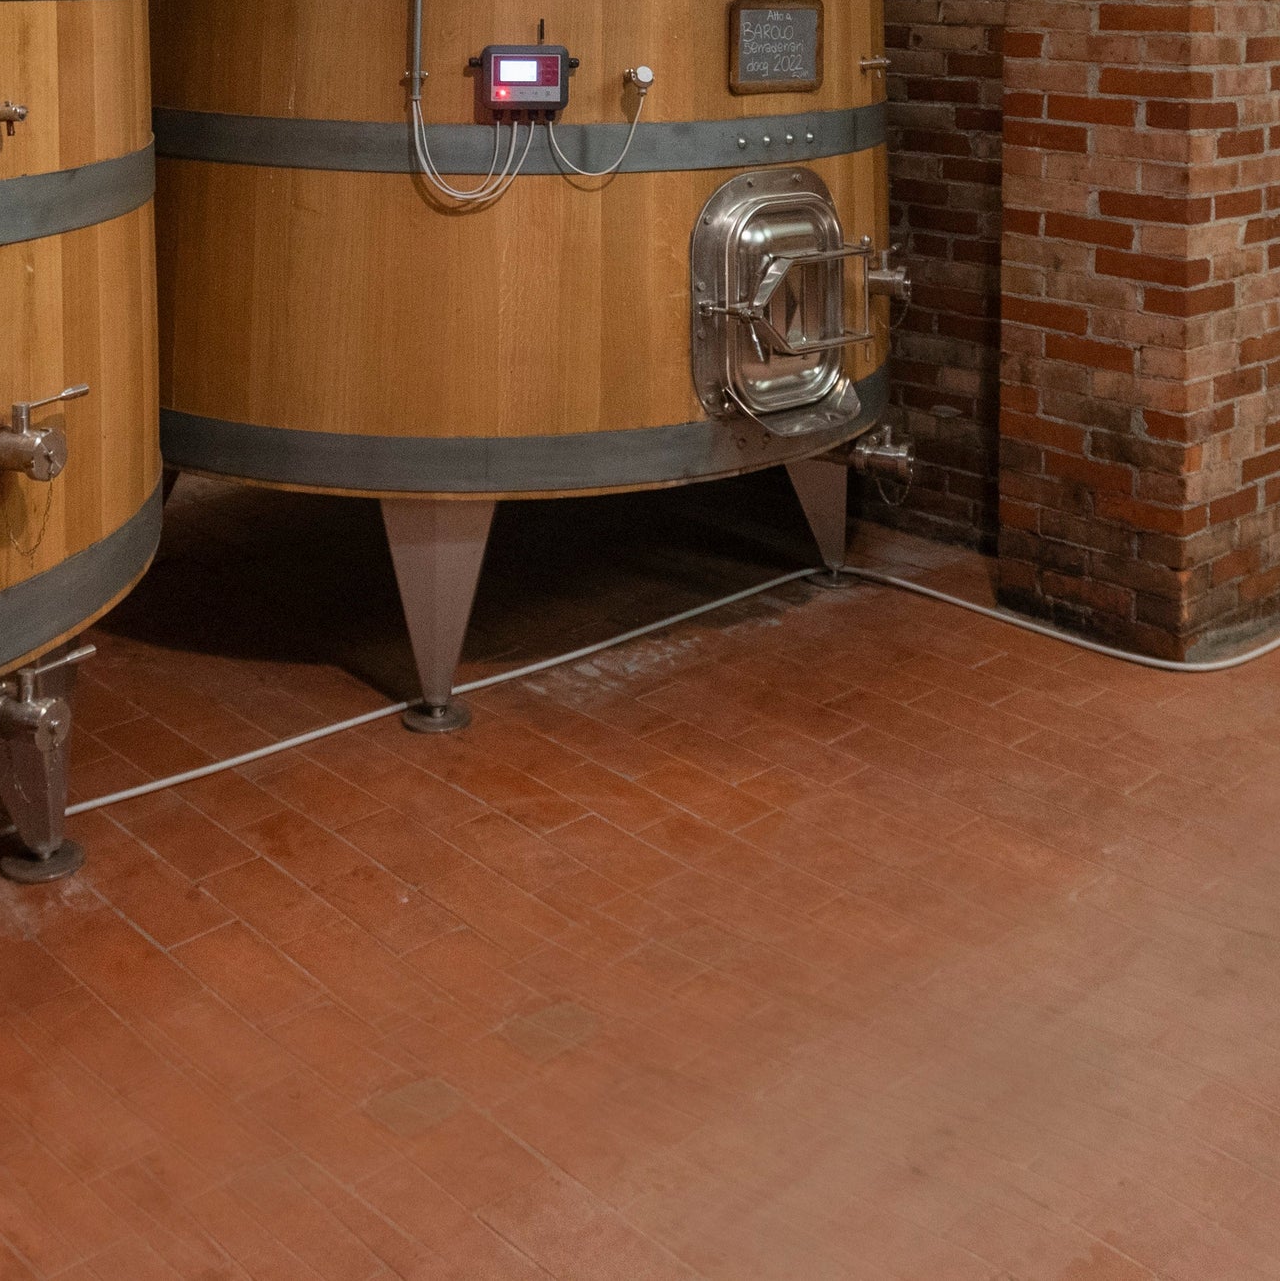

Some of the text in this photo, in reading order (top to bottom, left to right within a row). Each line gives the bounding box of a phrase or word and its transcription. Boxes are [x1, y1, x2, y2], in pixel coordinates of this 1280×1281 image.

[742, 21, 794, 42] BAROLO
[746, 54, 804, 77] docg 2022
